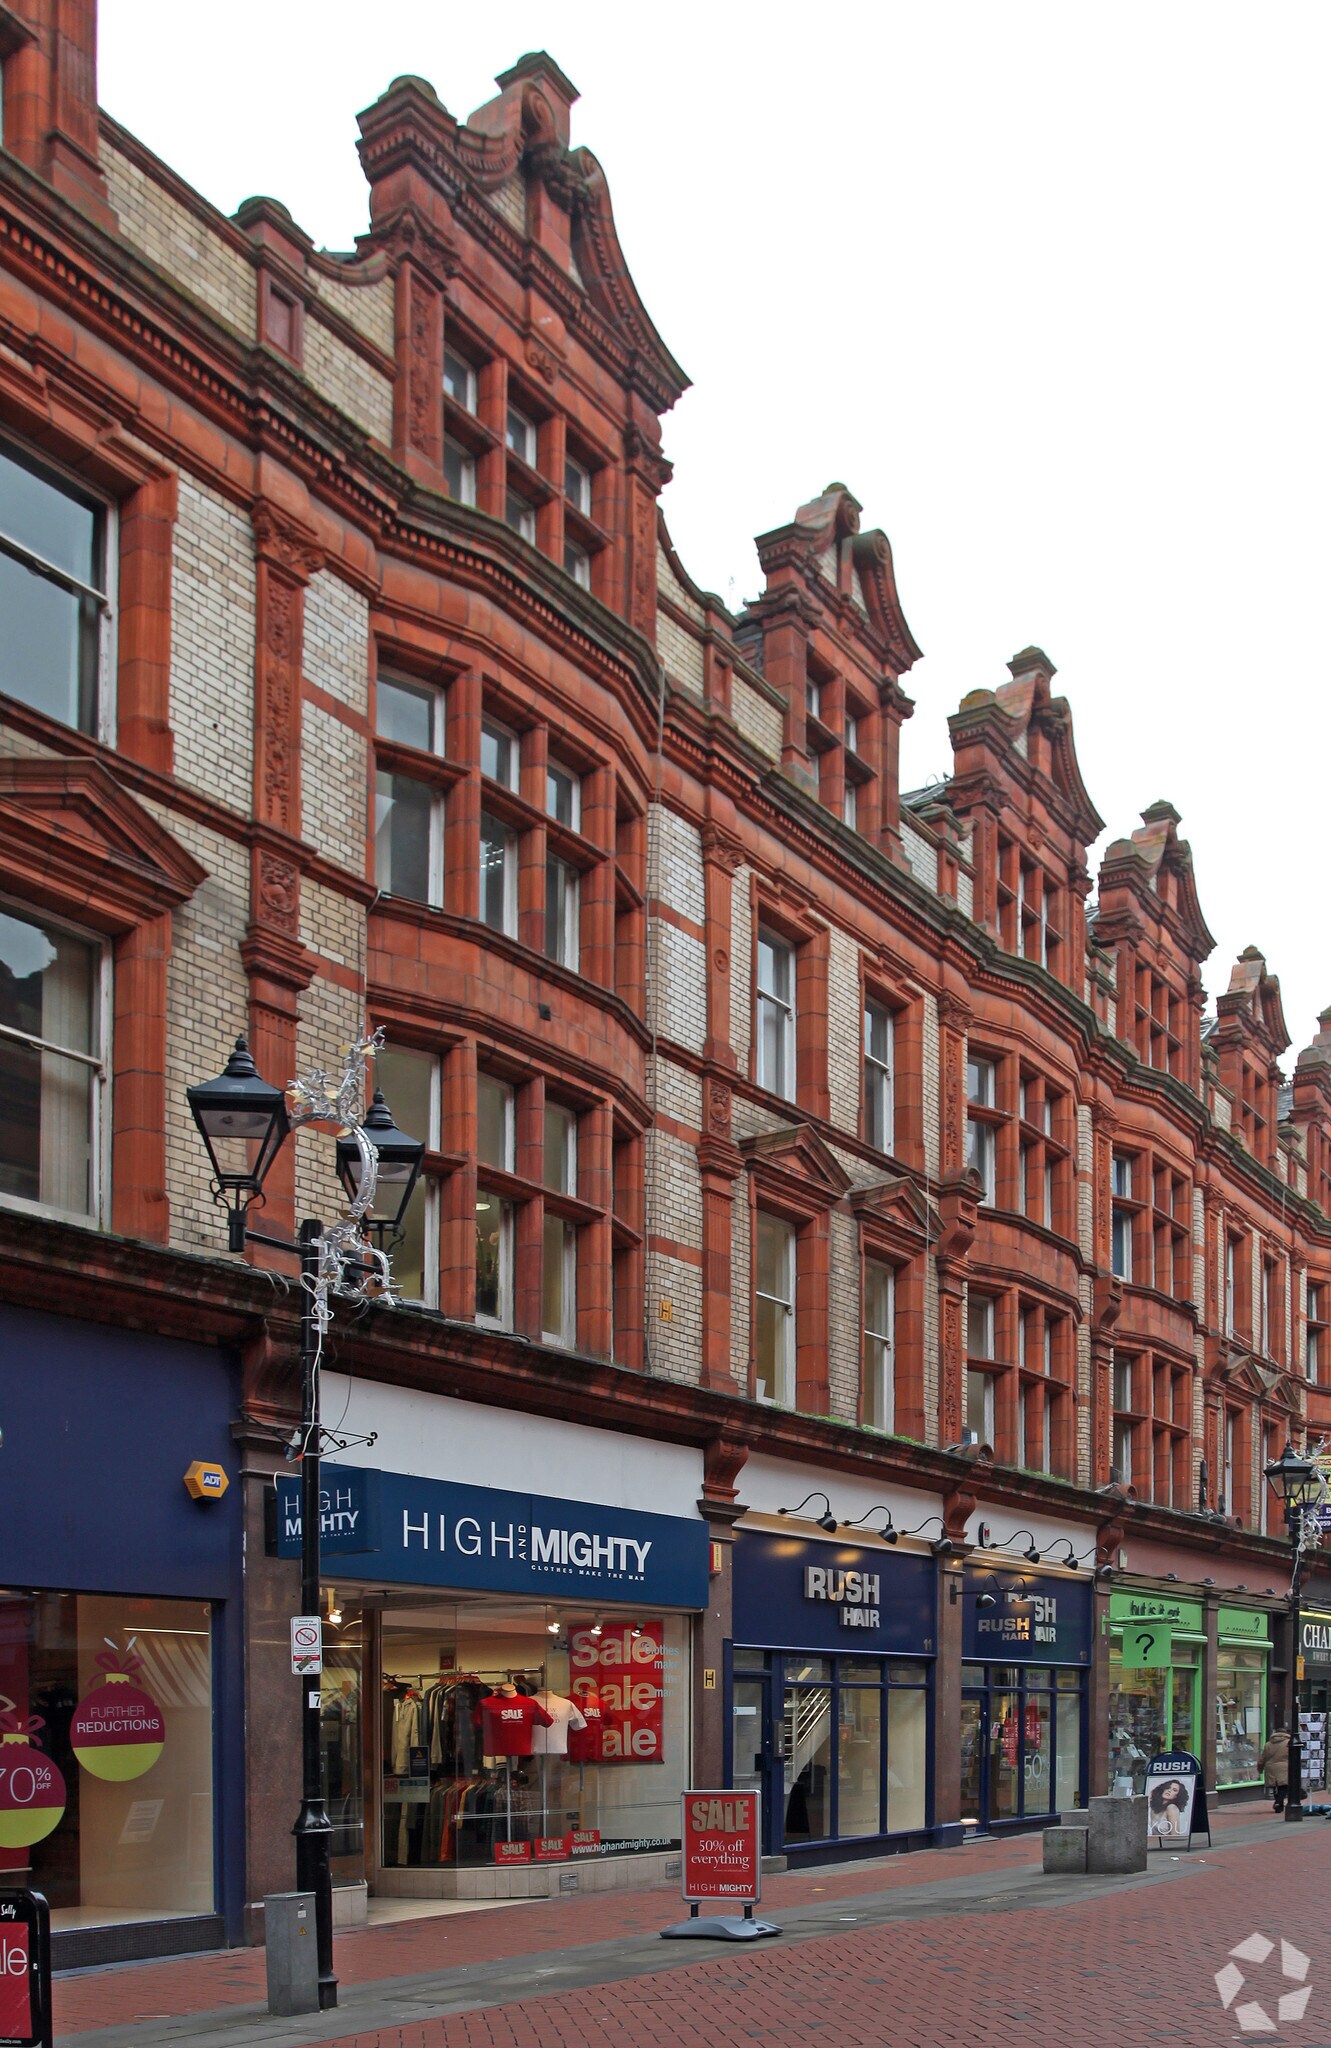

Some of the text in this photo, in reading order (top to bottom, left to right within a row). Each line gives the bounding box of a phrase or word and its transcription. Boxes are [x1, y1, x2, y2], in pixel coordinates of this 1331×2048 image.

[203, 1475, 221, 1486] ADT
[285, 1488, 351, 1515] HGH
[285, 1510, 359, 1536] MHTY
[403, 1509, 653, 1573] HIGH AND MIGHTY
[531, 1564, 573, 1574] CLOTHES
[579, 1569, 602, 1577] MAKE
[804, 1566, 880, 1605] RUSH
[840, 1606, 880, 1628] HAIR
[978, 1617, 1030, 1632] RUSH
[1001, 1631, 1030, 1641] HAIR
[572, 1629, 656, 1668] Sale
[90, 1705, 145, 1718] FURTHER
[501, 1708, 523, 1720] SALE
[583, 1707, 601, 1718] SALE
[77, 1719, 160, 1733] REDUCTIONS
[1153, 1761, 1191, 1771] RUSH
[691, 1799, 750, 1833] SALE
[573, 1831, 595, 1843] SALE
[501, 1842, 525, 1856] SALE
[541, 1839, 563, 1851] SALE
[572, 1838, 672, 1855] www.highandmighty.co.uk
[699, 1839, 745, 1852] 50% off
[691, 1852, 750, 1869] everything
[689, 1883, 716, 1892] HIGH
[719, 1884, 753, 1892] MIGHTY
[1, 1903, 16, 1920] Sally
